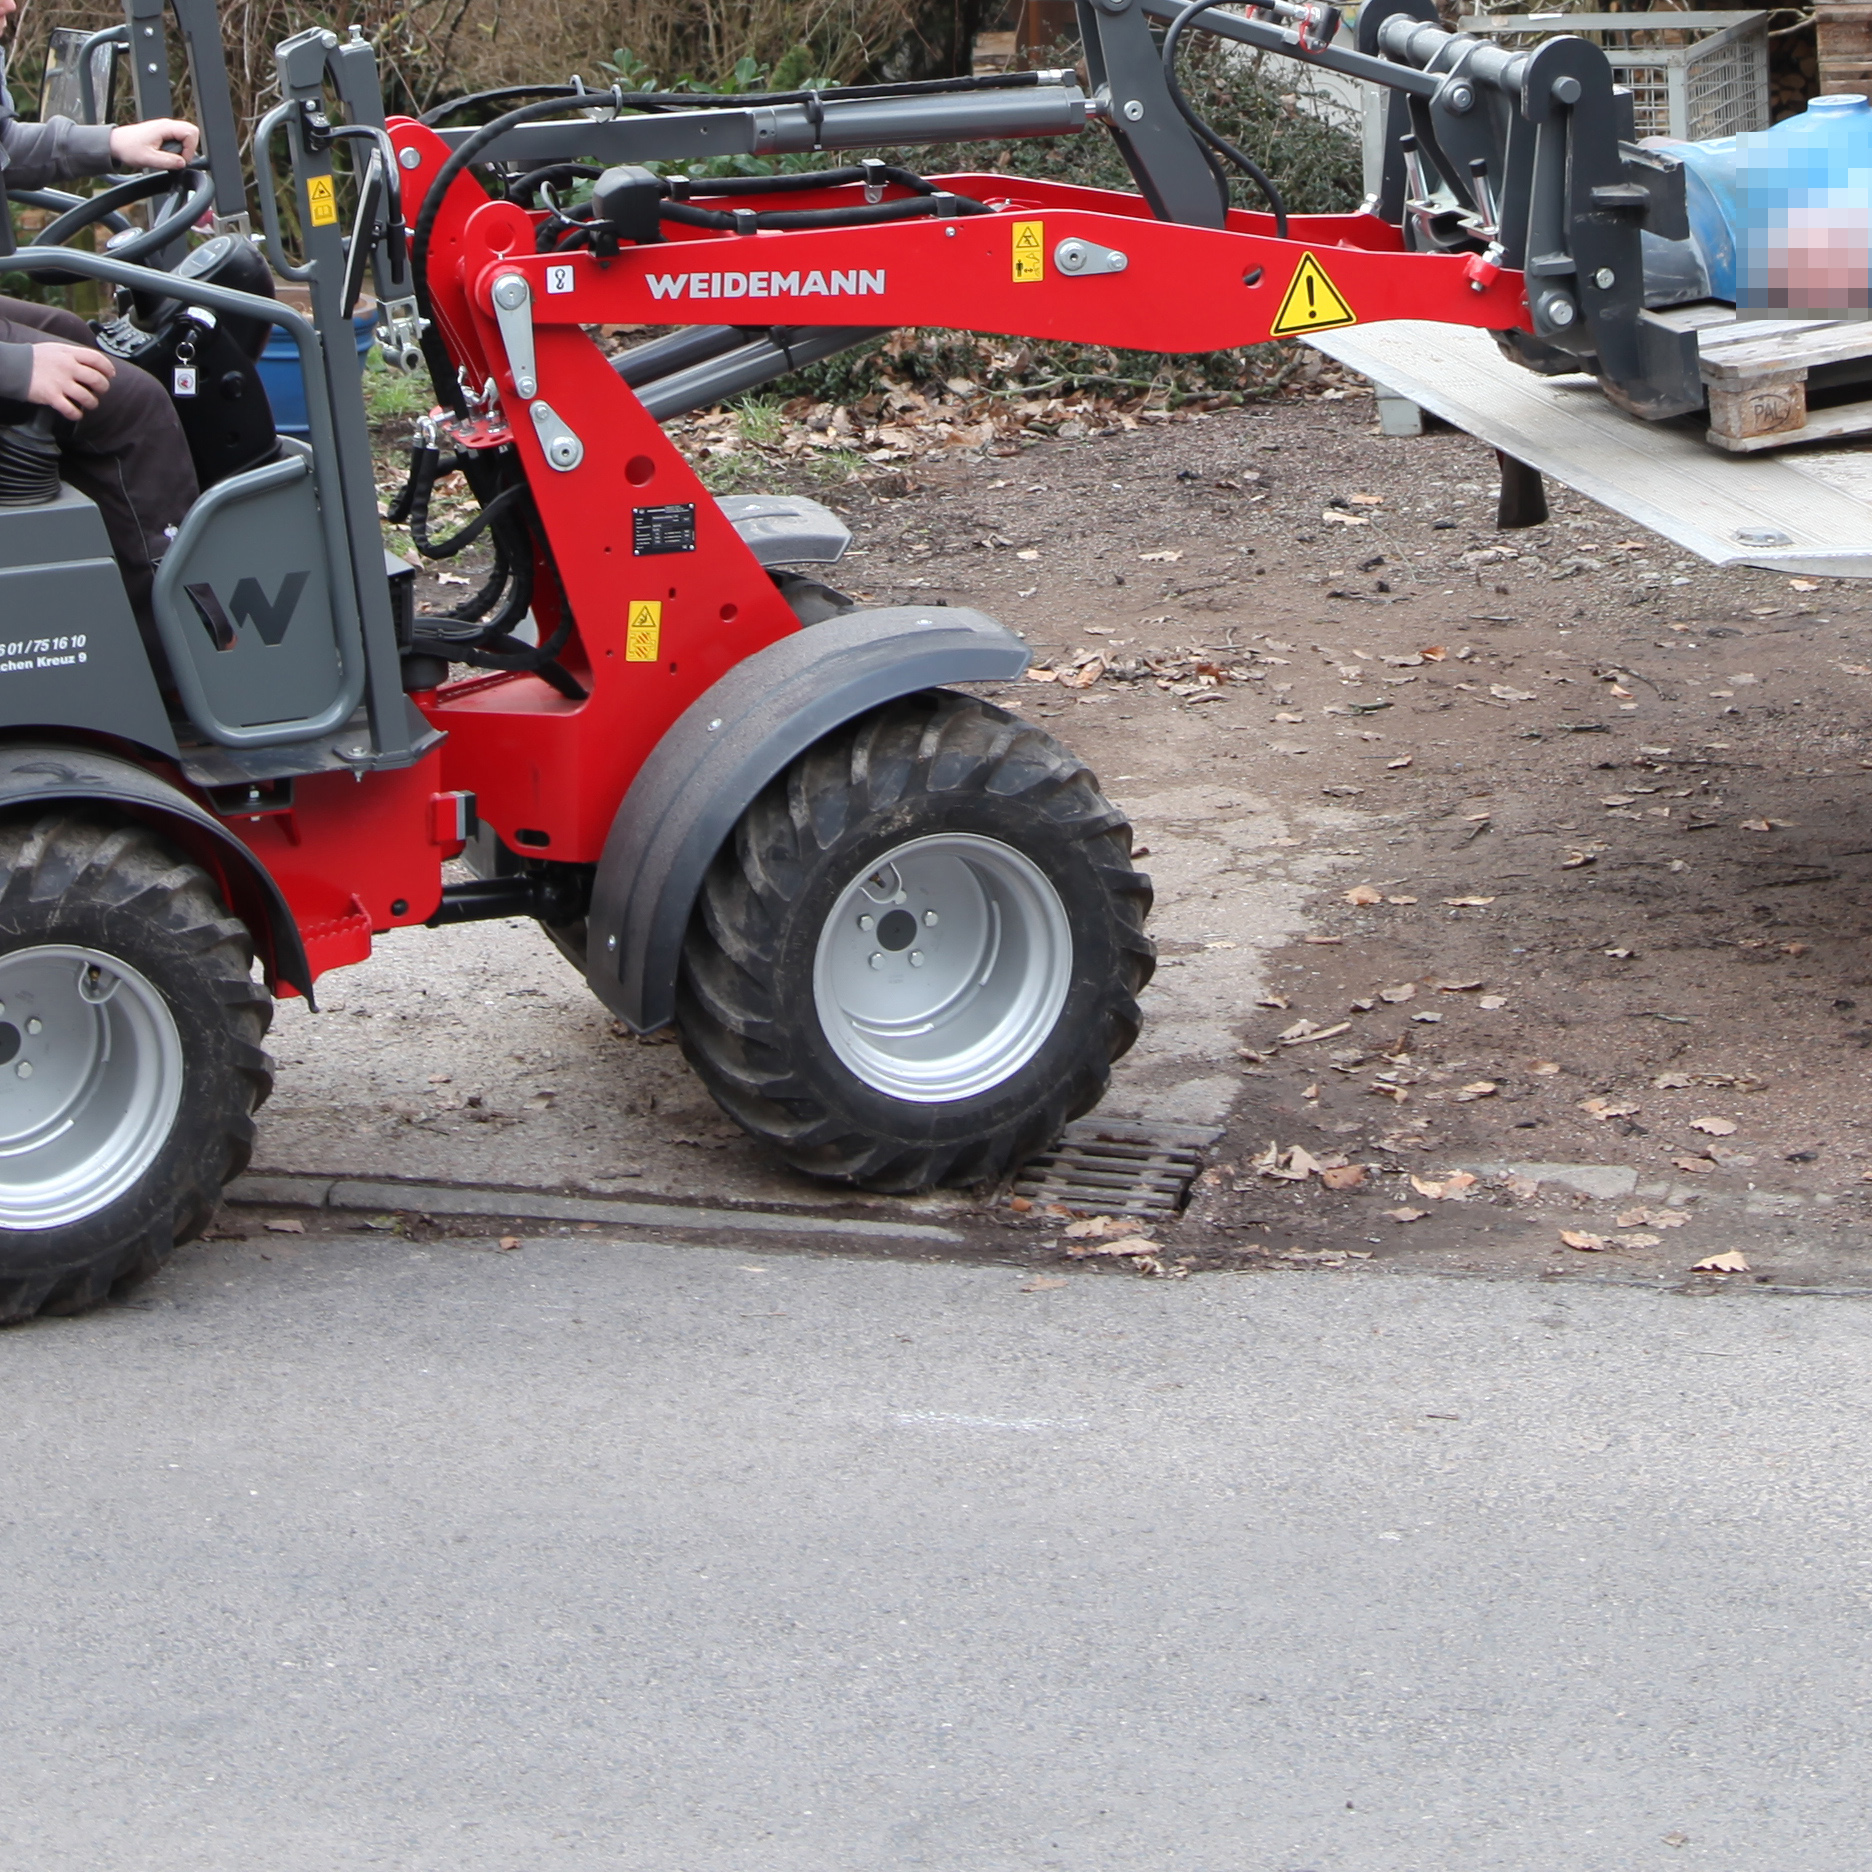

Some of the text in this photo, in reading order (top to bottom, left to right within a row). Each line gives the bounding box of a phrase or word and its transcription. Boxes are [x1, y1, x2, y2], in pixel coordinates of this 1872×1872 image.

[644, 269, 886, 300] WEIDEMANN
[36, 653, 76, 669] Kreuz
[77, 651, 88, 663] 9
